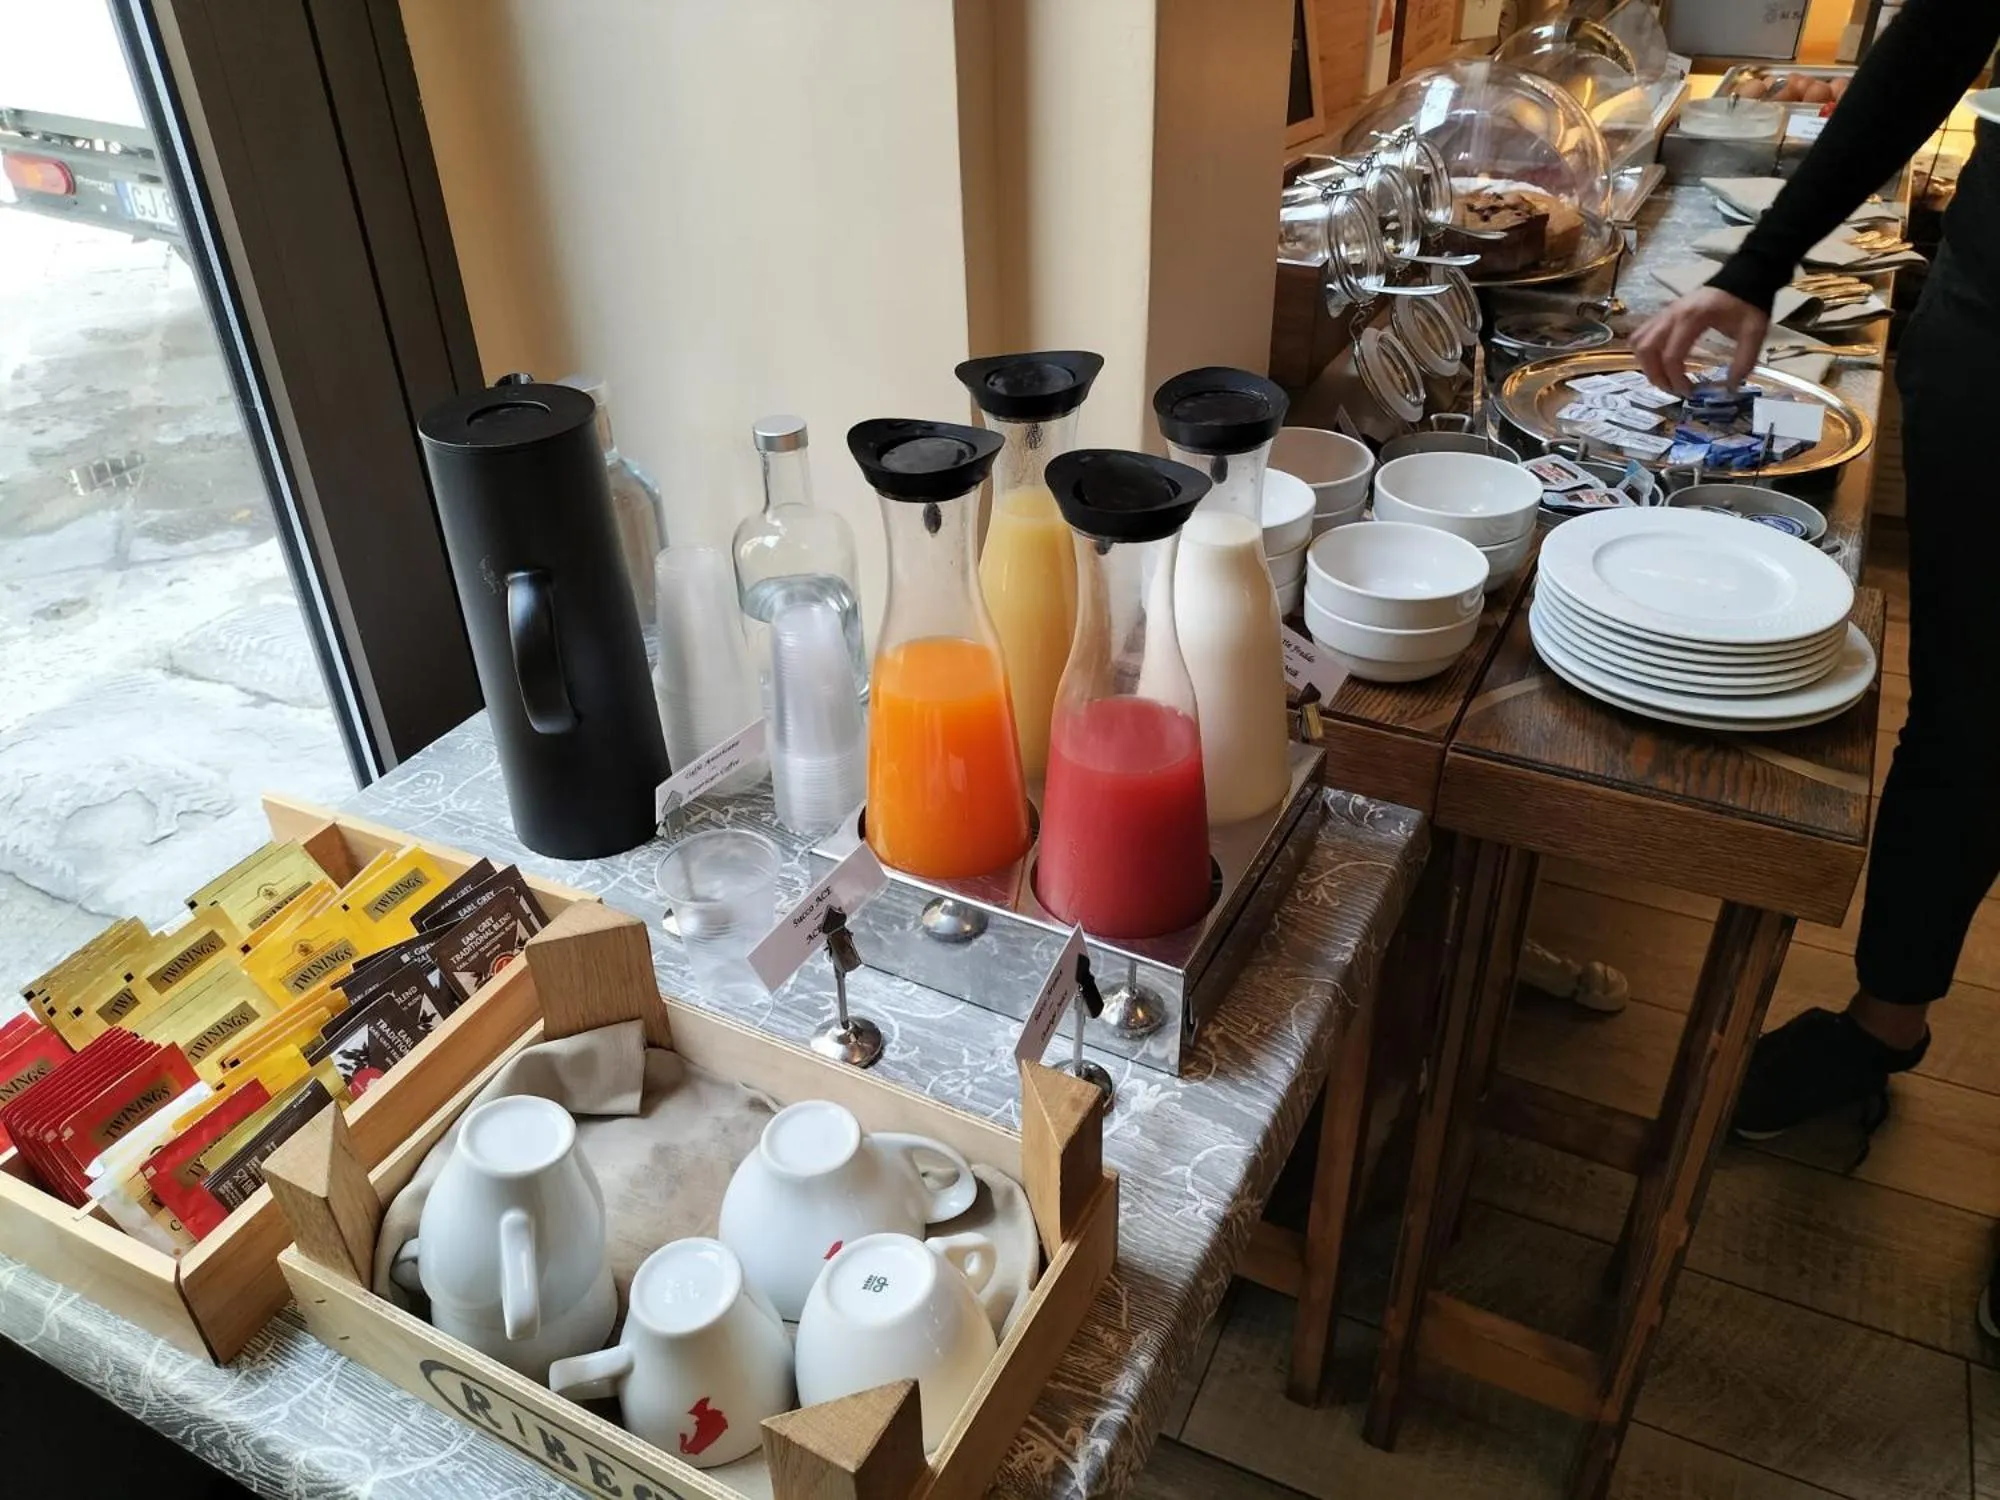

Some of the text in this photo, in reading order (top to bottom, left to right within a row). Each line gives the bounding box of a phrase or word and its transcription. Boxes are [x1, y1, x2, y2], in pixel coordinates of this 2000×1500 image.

[373, 877, 424, 914] TWININGS
[458, 889, 496, 918] EARL GREY
[792, 885, 832, 928] Succo ACE
[449, 928, 494, 965] TRADITIONAL
[492, 911, 512, 931] BLEND
[461, 915, 495, 946] EARL GREY
[160, 940, 218, 984] TWININGS
[292, 947, 353, 991] TWININGS
[187, 1011, 250, 1060] TWININGS
[397, 1029, 415, 1048] EARL
[102, 1085, 171, 1141] TWININGS
